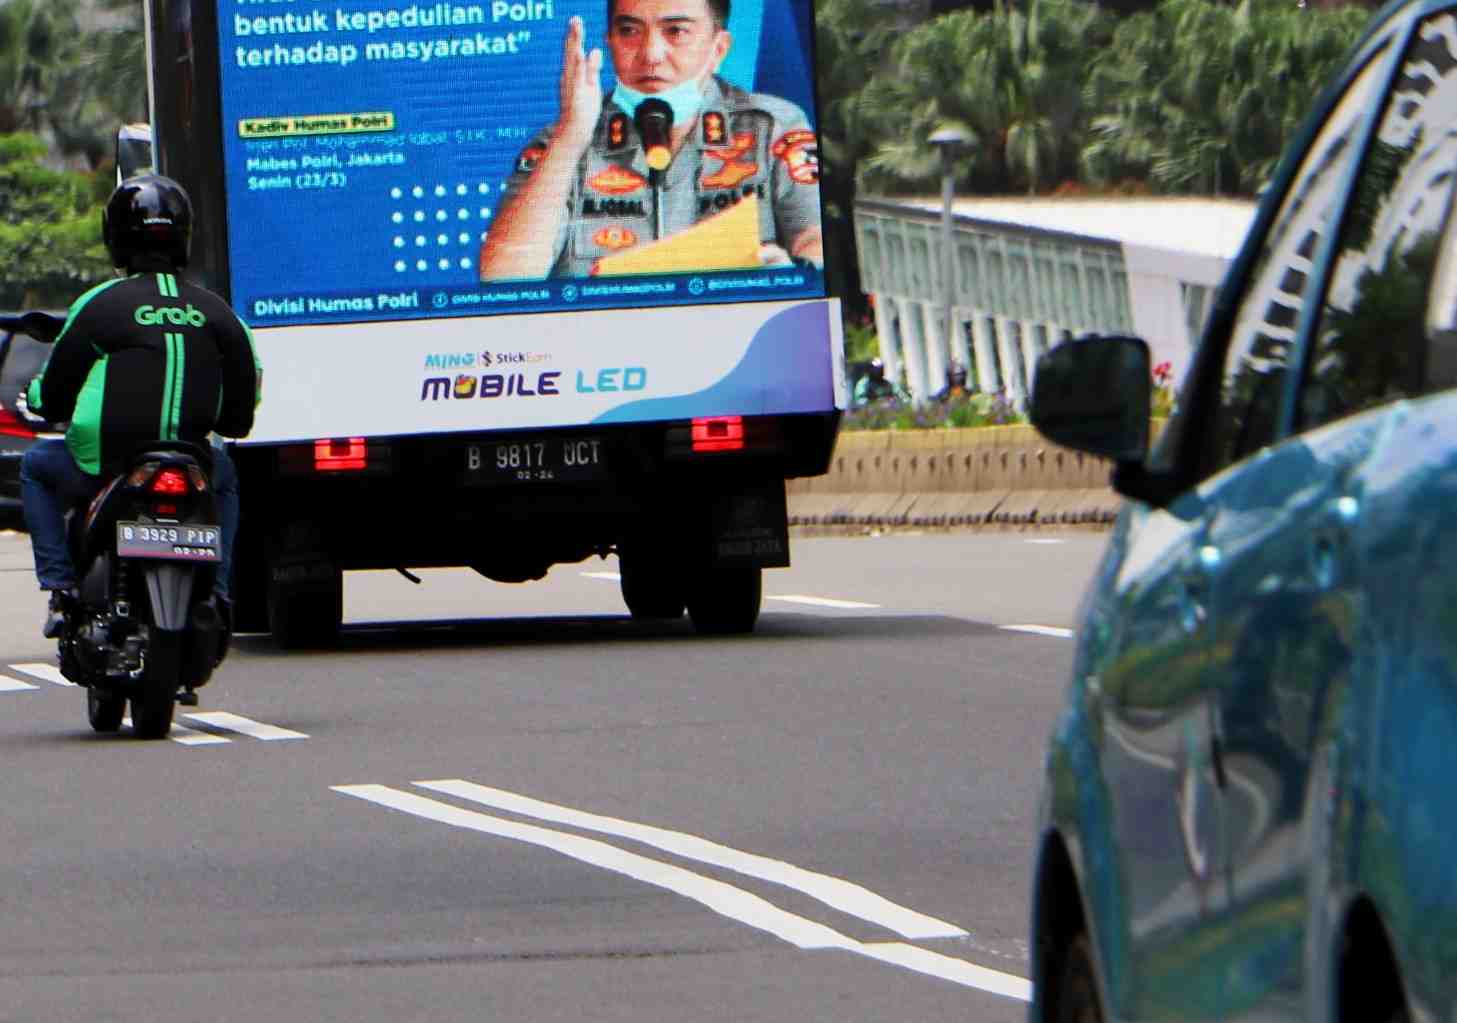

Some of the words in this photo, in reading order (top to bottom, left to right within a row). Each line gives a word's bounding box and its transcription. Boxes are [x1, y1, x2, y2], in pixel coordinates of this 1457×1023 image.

[234, 8, 329, 37] bentuk
[336, 2, 484, 33] kepedulian
[236, 40, 358, 68] terhadap
[134, 303, 207, 328] Grab
[254, 296, 305, 316] Divisi
[308, 295, 374, 312] Humas
[378, 290, 419, 310] Polri
[421, 371, 562, 401] MOBILE
[576, 367, 647, 394] LED
[496, 442, 545, 468] 9817
